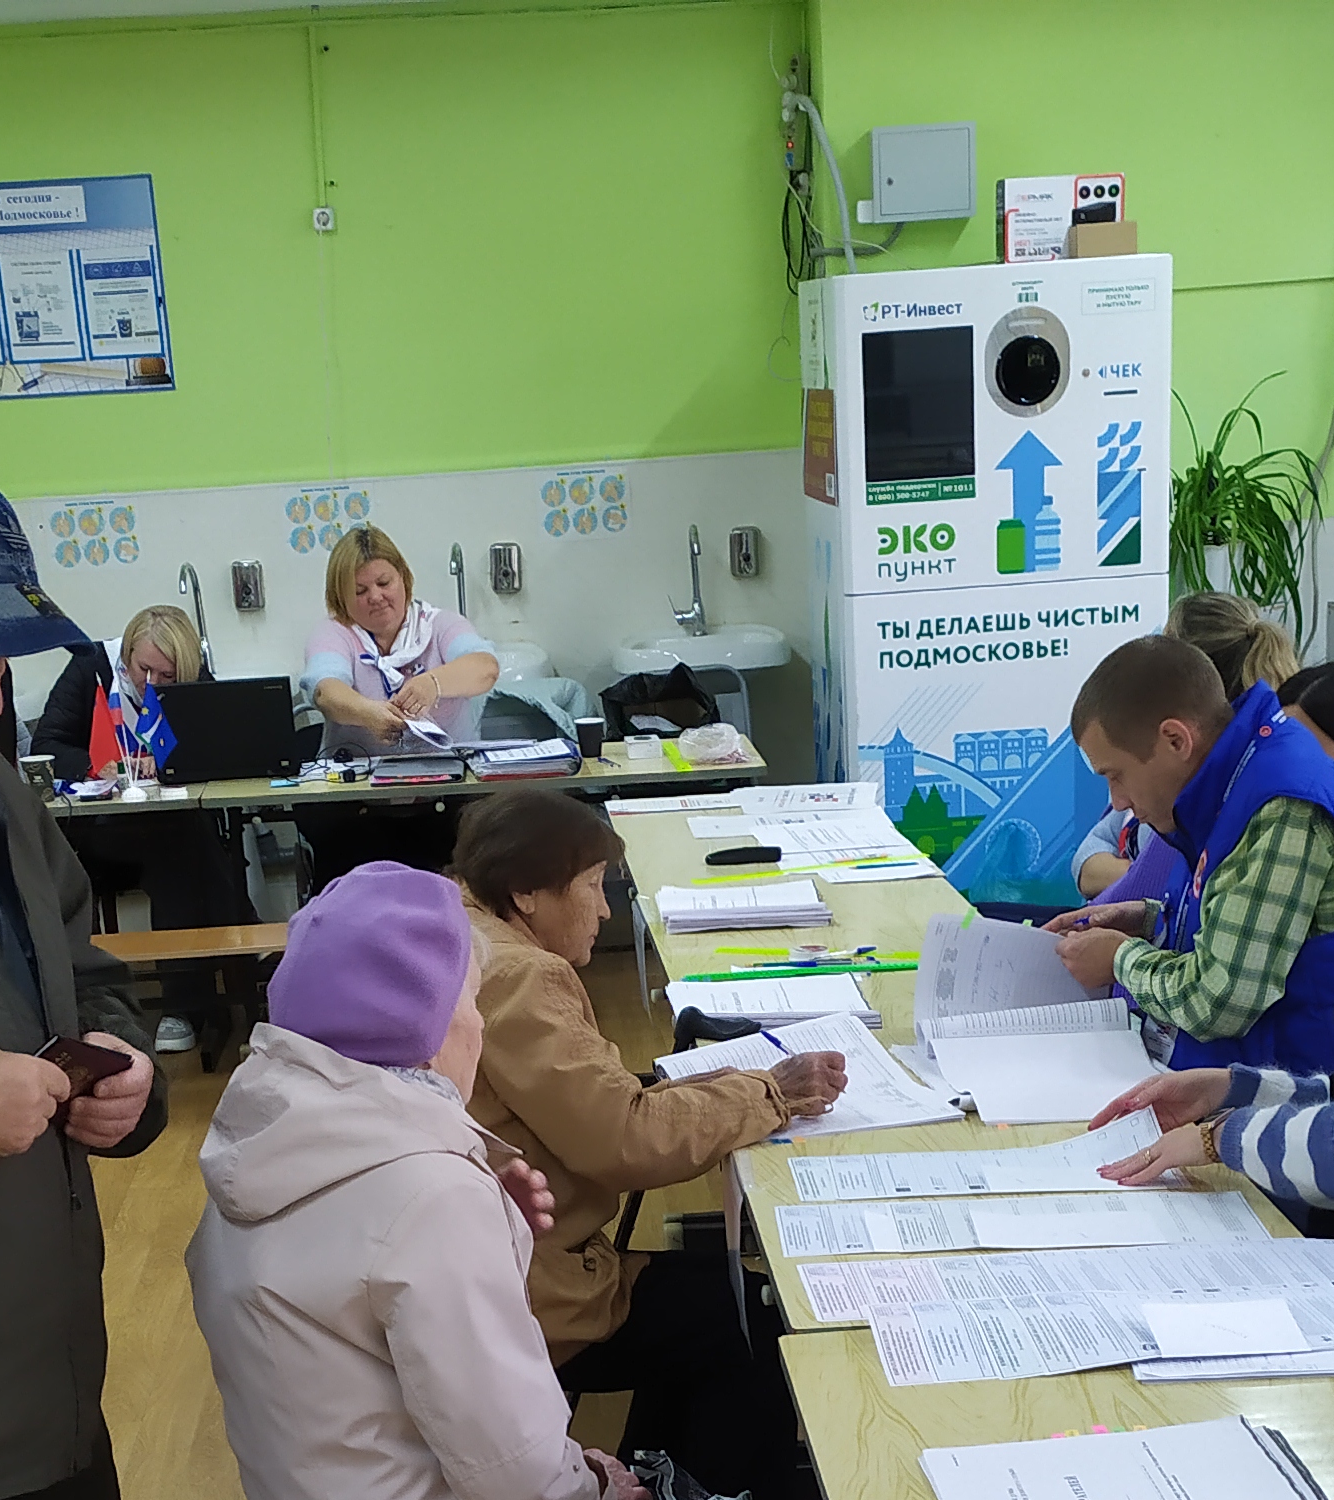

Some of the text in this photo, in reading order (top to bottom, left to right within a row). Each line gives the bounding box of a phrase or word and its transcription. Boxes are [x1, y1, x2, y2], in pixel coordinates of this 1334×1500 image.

[7, 193, 52, 205] сегодня
[881, 303, 962, 319] РТ-Инвест
[1110, 363, 1142, 378] ЧЕК
[877, 523, 956, 556] ЭКО
[878, 558, 956, 582] пункт
[877, 604, 1140, 640] ТЫ ДЕЛАЕШЬ ЧИСТЫМ
[879, 638, 1070, 670] ПОДМОСКОВЬЕ!
